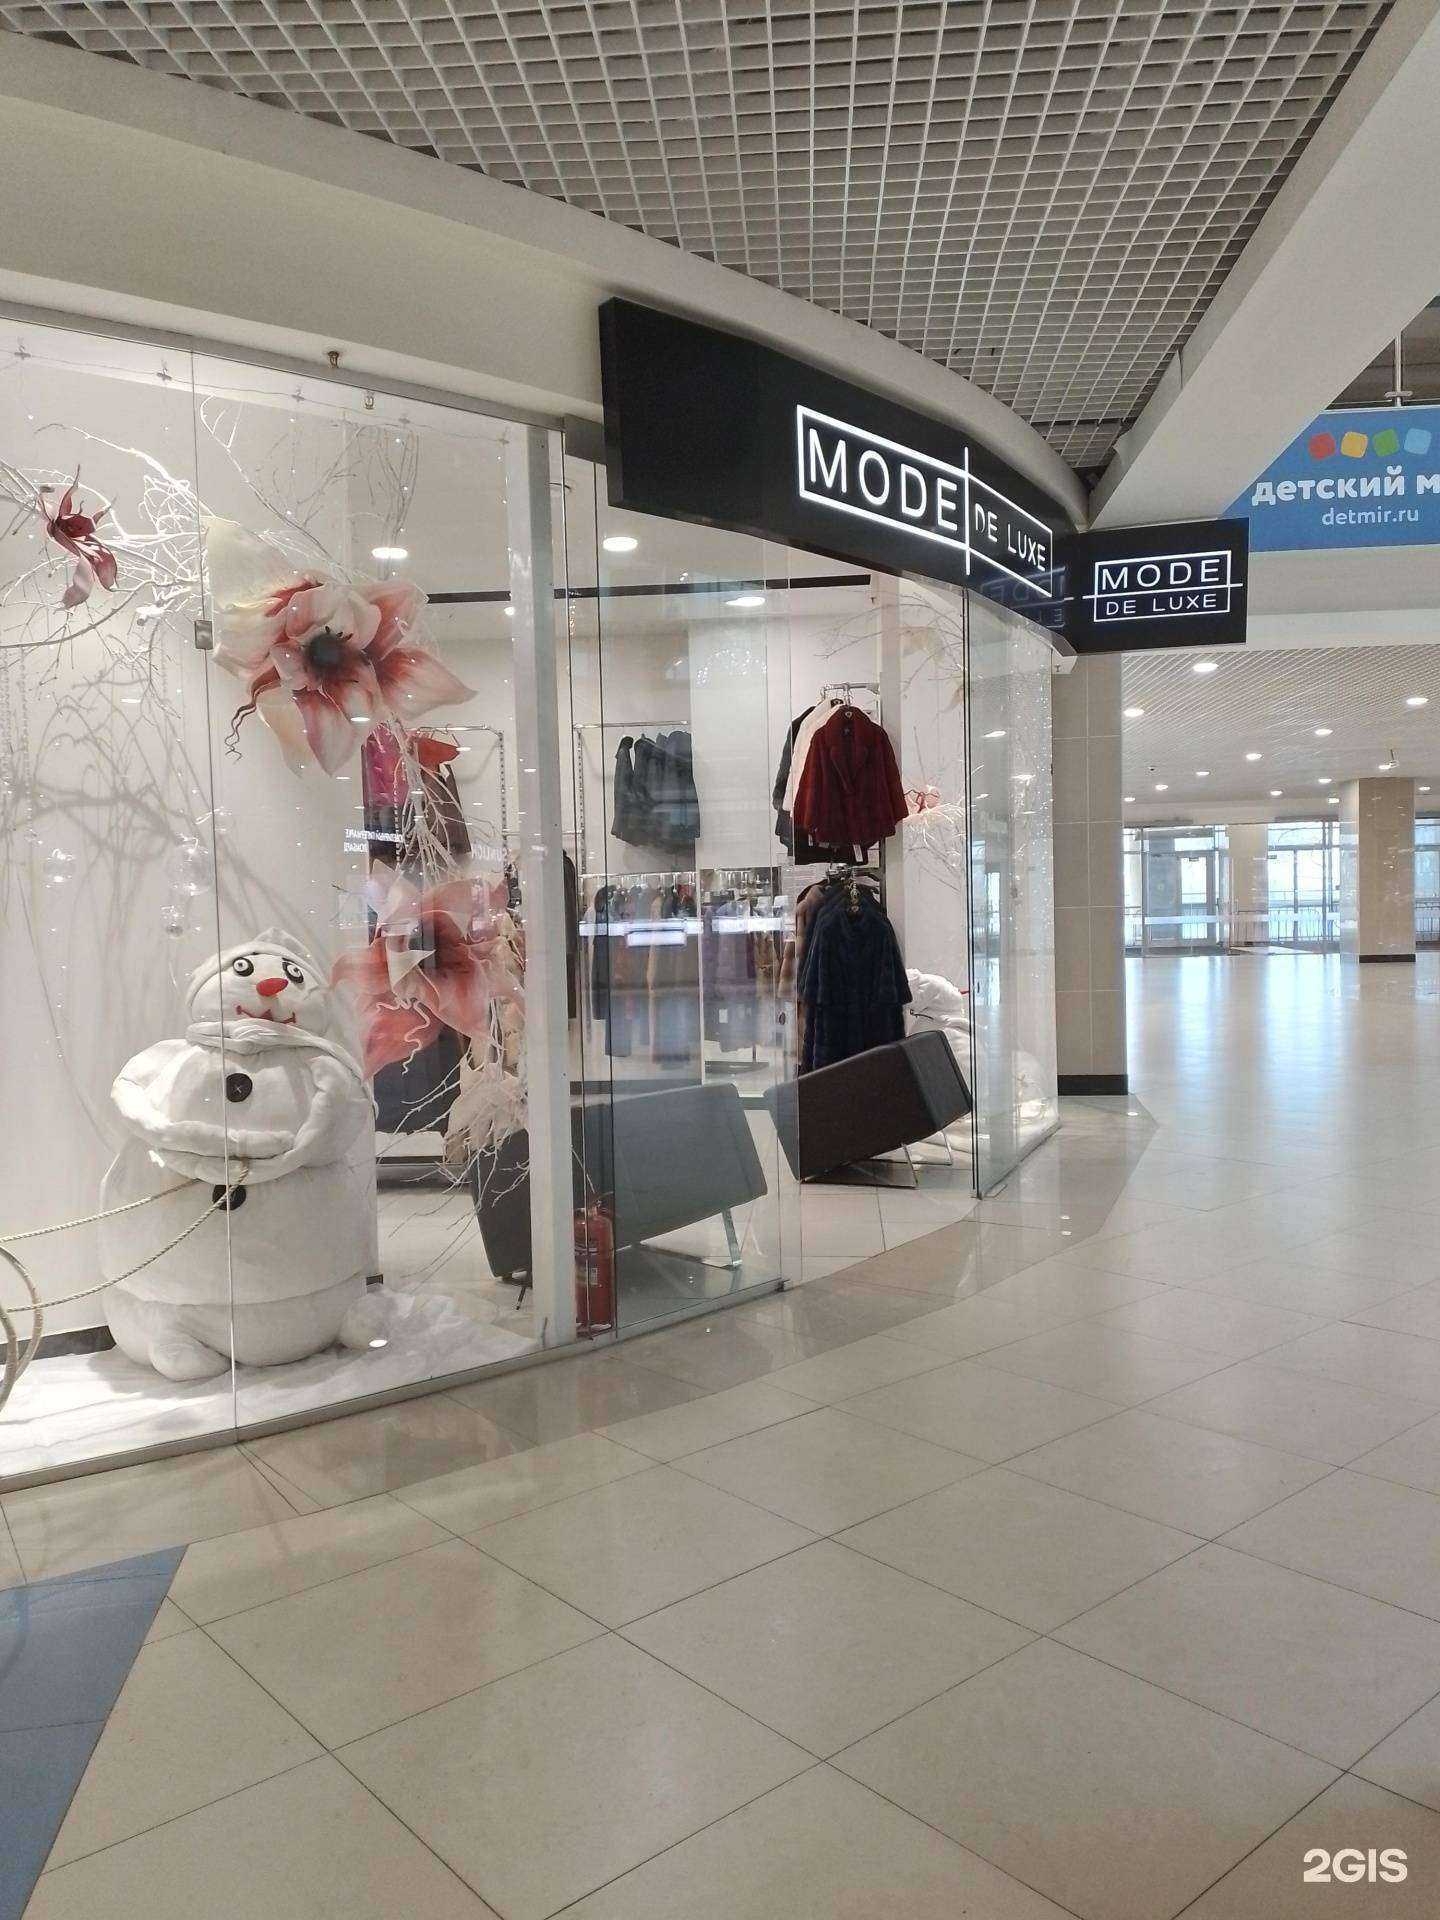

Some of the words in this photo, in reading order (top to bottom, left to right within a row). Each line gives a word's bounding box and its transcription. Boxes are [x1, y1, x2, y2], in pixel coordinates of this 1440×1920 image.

[808, 428, 958, 532] MODE
[975, 503, 998, 543] DE
[1007, 523, 1046, 572] LUXE
[1251, 465, 1405, 507] детский
[1321, 505, 1420, 526] detmir.ru
[1101, 559, 1221, 591] MODE
[1106, 600, 1137, 616] DE
[1152, 593, 1218, 612] LUXE
